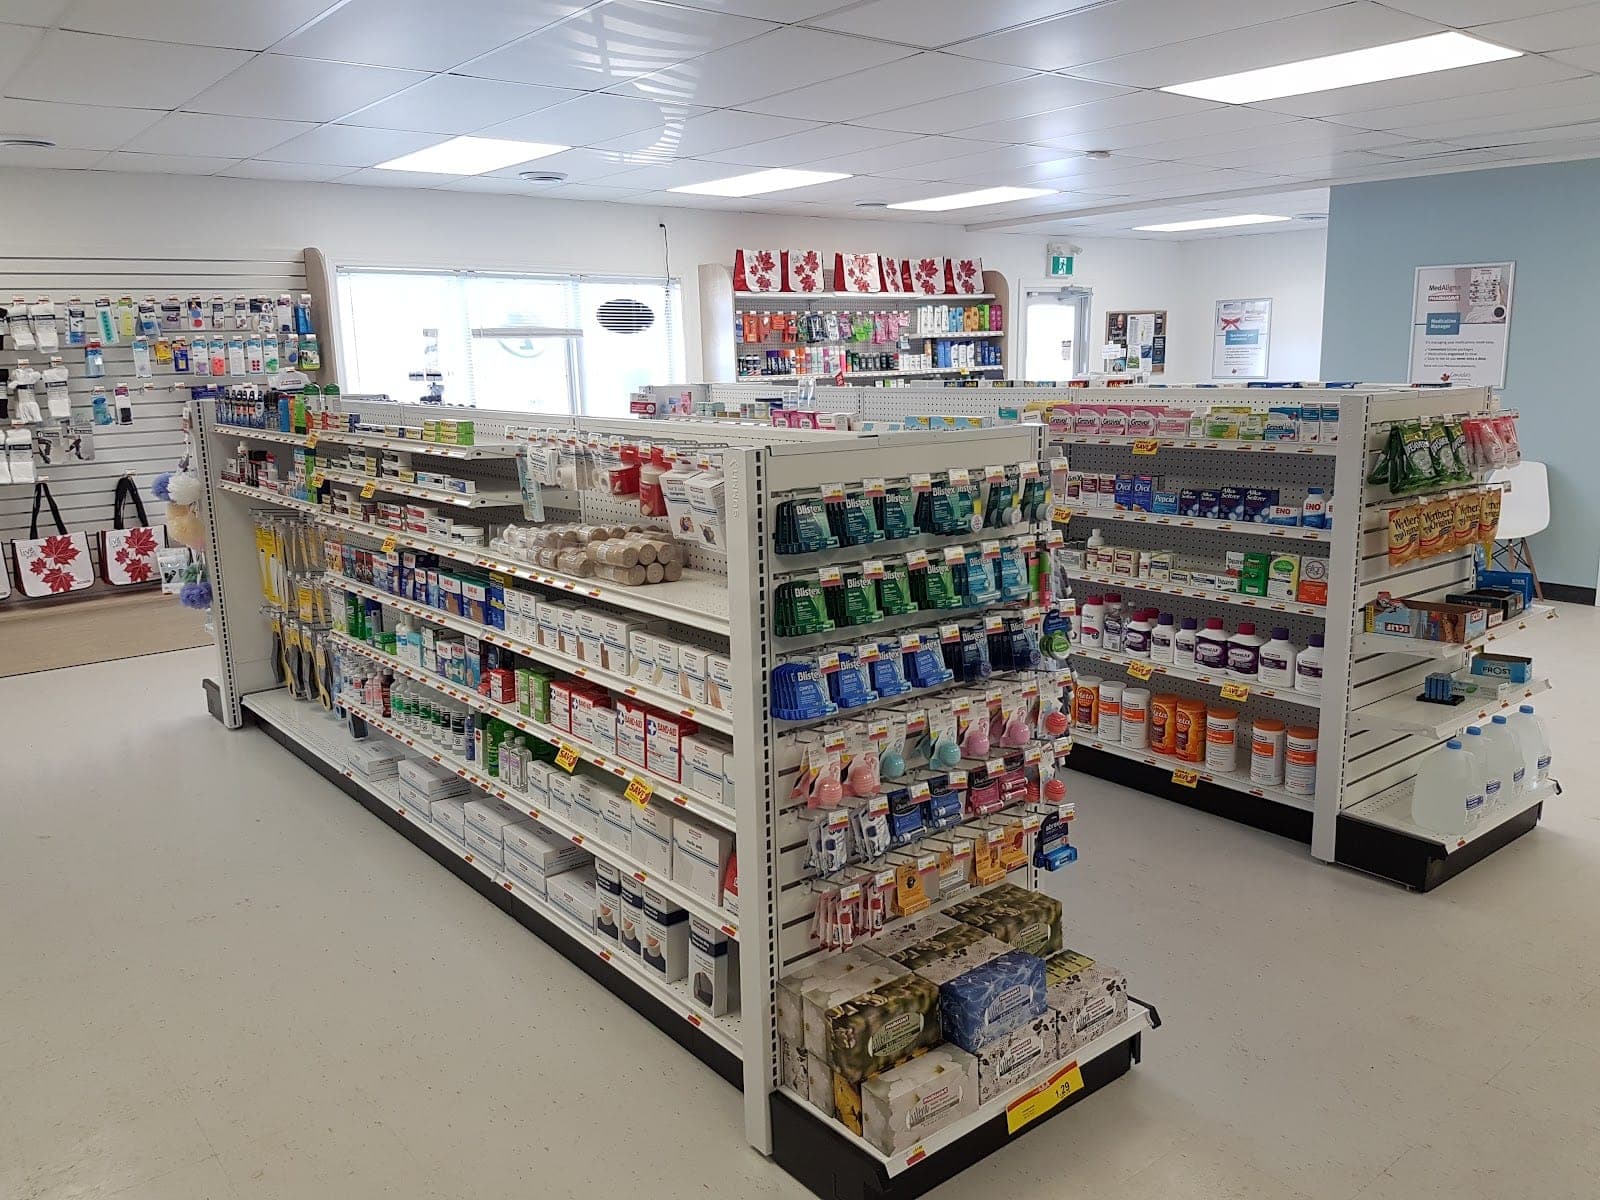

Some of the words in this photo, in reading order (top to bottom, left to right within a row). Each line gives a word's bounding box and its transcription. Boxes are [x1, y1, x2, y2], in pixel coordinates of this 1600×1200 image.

[1078, 417, 1095, 426] Gravol
[1103, 418, 1121, 426] Gravol
[1131, 418, 1149, 427] Gravol
[932, 486, 956, 498] Blistex
[1134, 482, 1151, 492] Ovol
[846, 497, 872, 510] Blistex
[886, 493, 911, 504] Blistex
[1155, 495, 1176, 504] Pepcid
[796, 503, 824, 516] Blistex
[1306, 502, 1321, 511] ENO
[927, 564, 950, 575] Blistex
[882, 570, 907, 582] Blistex
[847, 578, 872, 590] Blistex
[794, 587, 822, 599] Blistex
[962, 631, 984, 642] Blistex
[841, 659, 868, 671] Blistex
[1483, 666, 1511, 675] FROST
[797, 670, 824, 683] Blistex
[625, 716, 643, 729] BAND-AID
[657, 722, 677, 736] BAND-AID
[559, 750, 575, 764] SAVE
[629, 783, 646, 801] SAVE
[1056, 1081, 1070, 1098] 1.29
